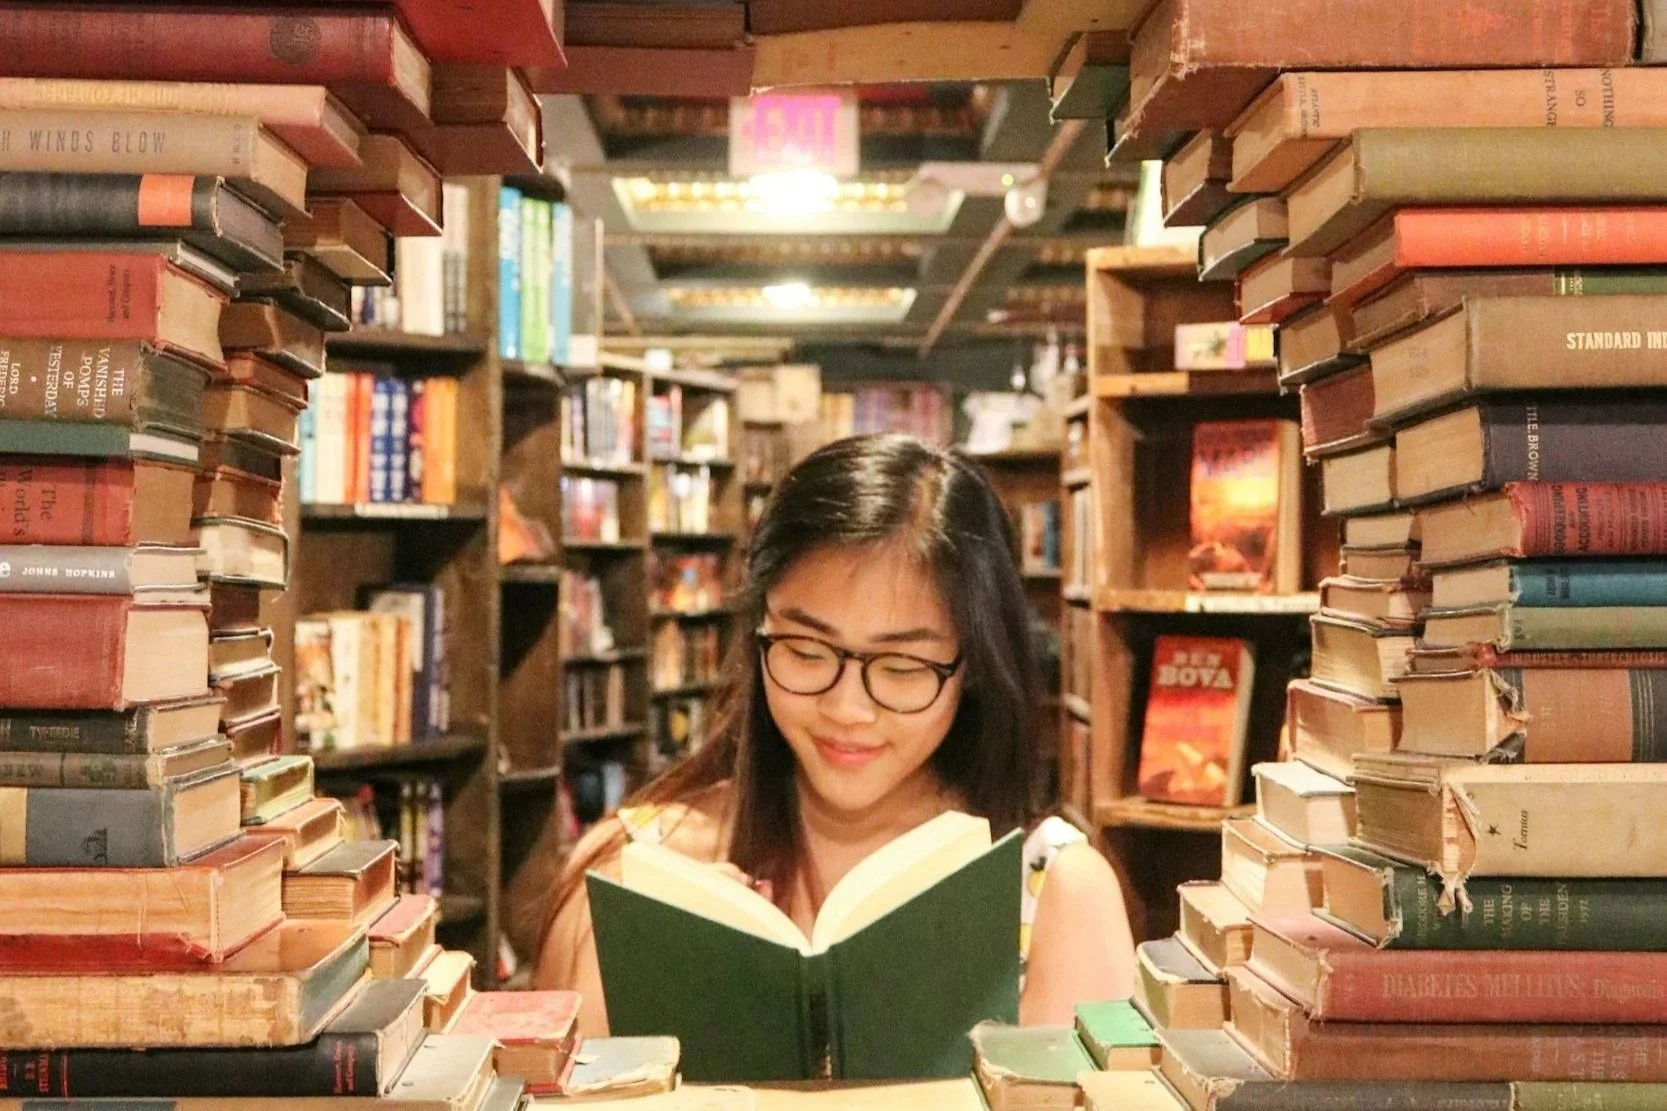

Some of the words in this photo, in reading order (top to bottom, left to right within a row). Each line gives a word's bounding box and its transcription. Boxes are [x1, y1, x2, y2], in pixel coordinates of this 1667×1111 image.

[1541, 71, 1557, 127] STRANGE
[1575, 89, 1585, 107] SO
[1600, 68, 1615, 128] NOTHING
[30, 130, 95, 153] WINDS
[112, 131, 167, 154] BLOW
[1566, 331, 1642, 350] STANDARD
[9, 362, 21, 395] LORD
[44, 345, 63, 419] YESTERDAY
[63, 370, 75, 389] OF
[76, 355, 93, 407] POMPS
[93, 347, 111, 419] VANISHED
[111, 368, 125, 397] THE
[1526, 434, 1540, 481] BROWN
[14, 468, 33, 538] World's
[40, 483, 57, 523] The
[1575, 487, 1591, 552] ACCOUNTING
[22, 567, 59, 577] JOHNS
[65, 568, 117, 579] HOPKINS
[1157, 665, 1234, 689] BOVA
[1483, 898, 1495, 927] THE
[1500, 884, 1514, 937] MAKING
[1519, 901, 1533, 922] OF
[1538, 897, 1552, 926] THE
[1382, 972, 1477, 1000] DIABETES
